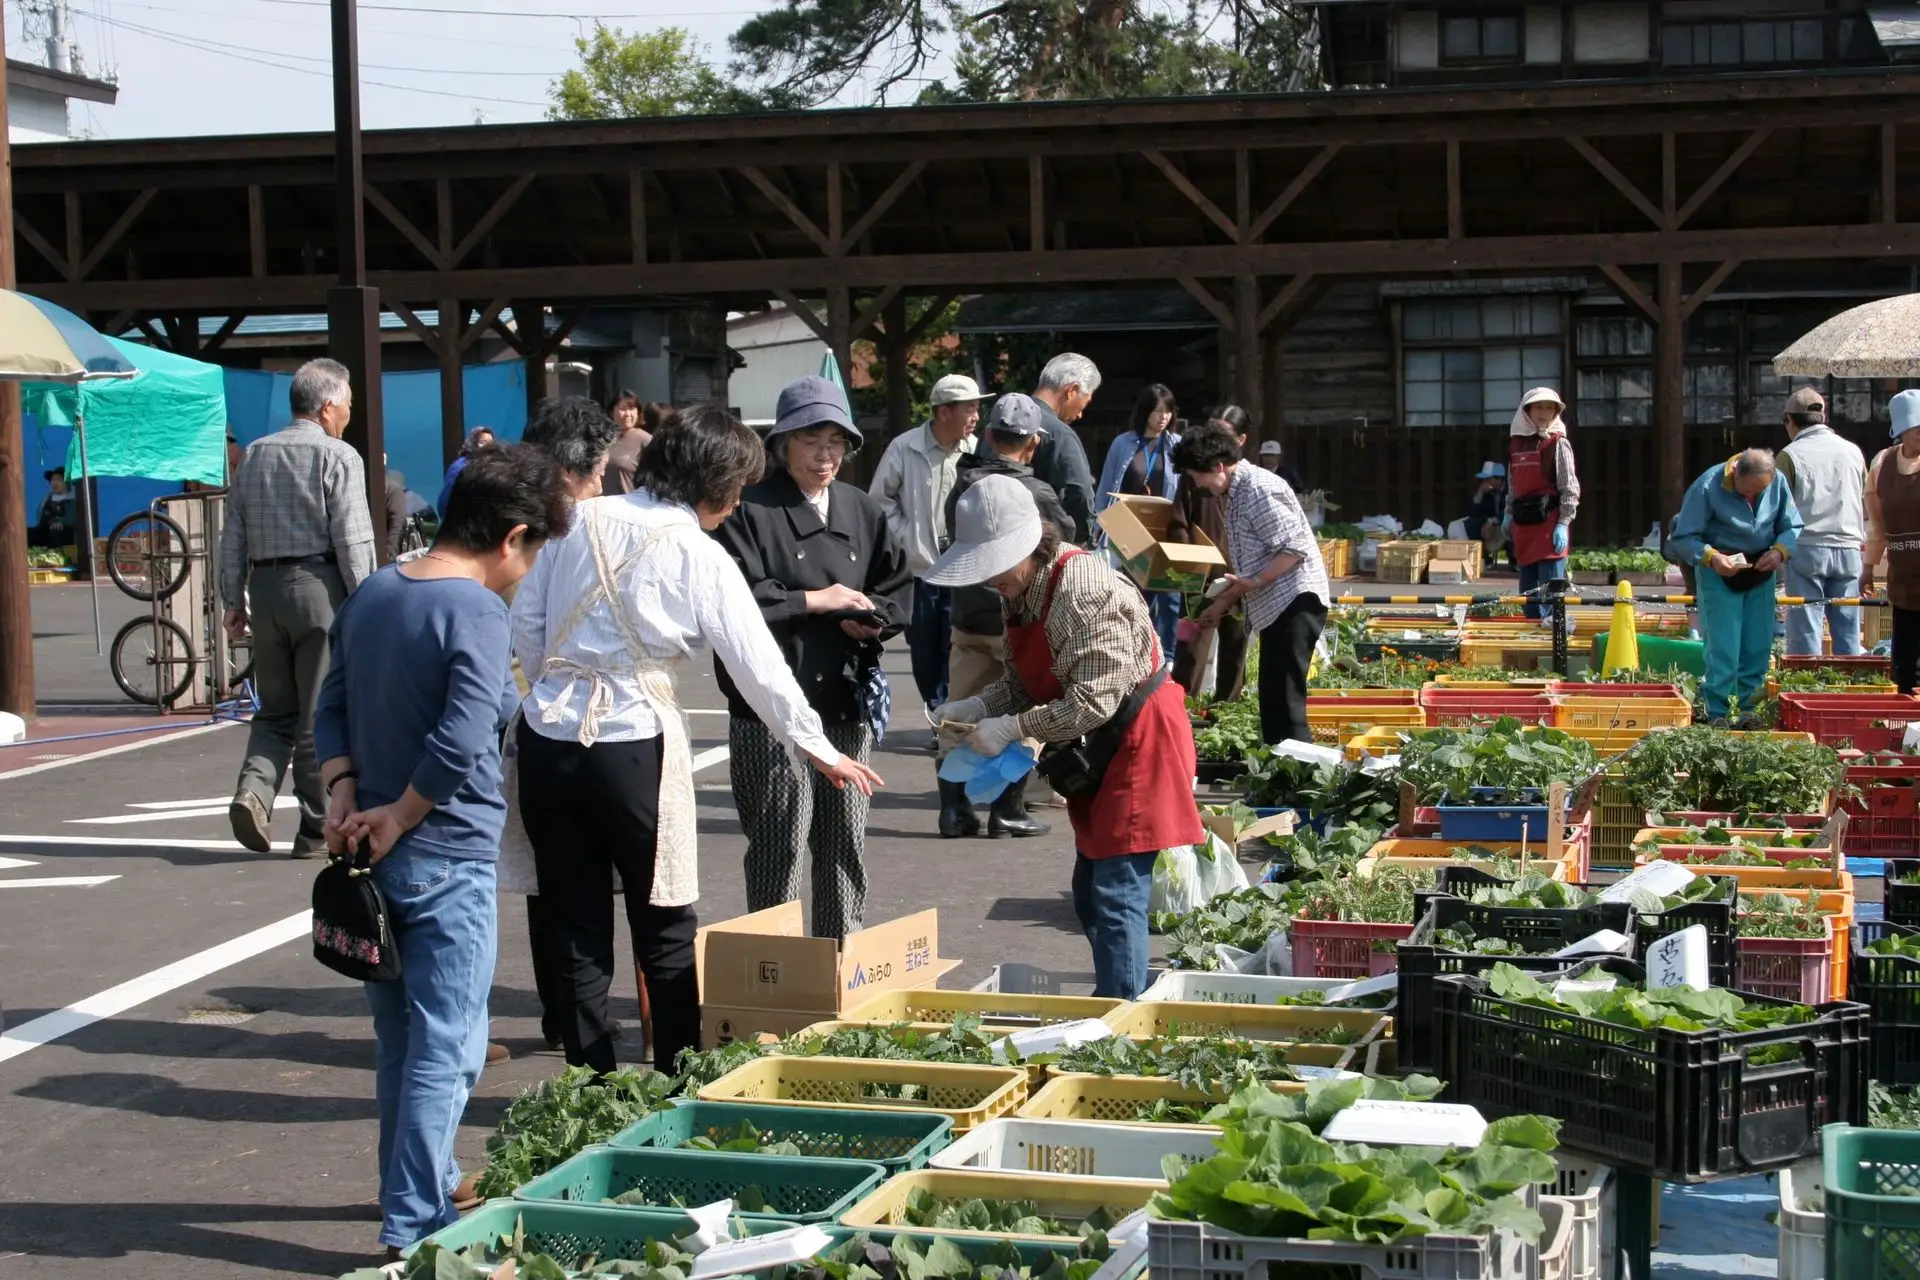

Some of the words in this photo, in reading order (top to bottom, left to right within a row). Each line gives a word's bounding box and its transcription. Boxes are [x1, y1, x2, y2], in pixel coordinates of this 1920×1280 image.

[905, 947, 930, 972] 玉ねぎ
[867, 962, 892, 984] ふらの
